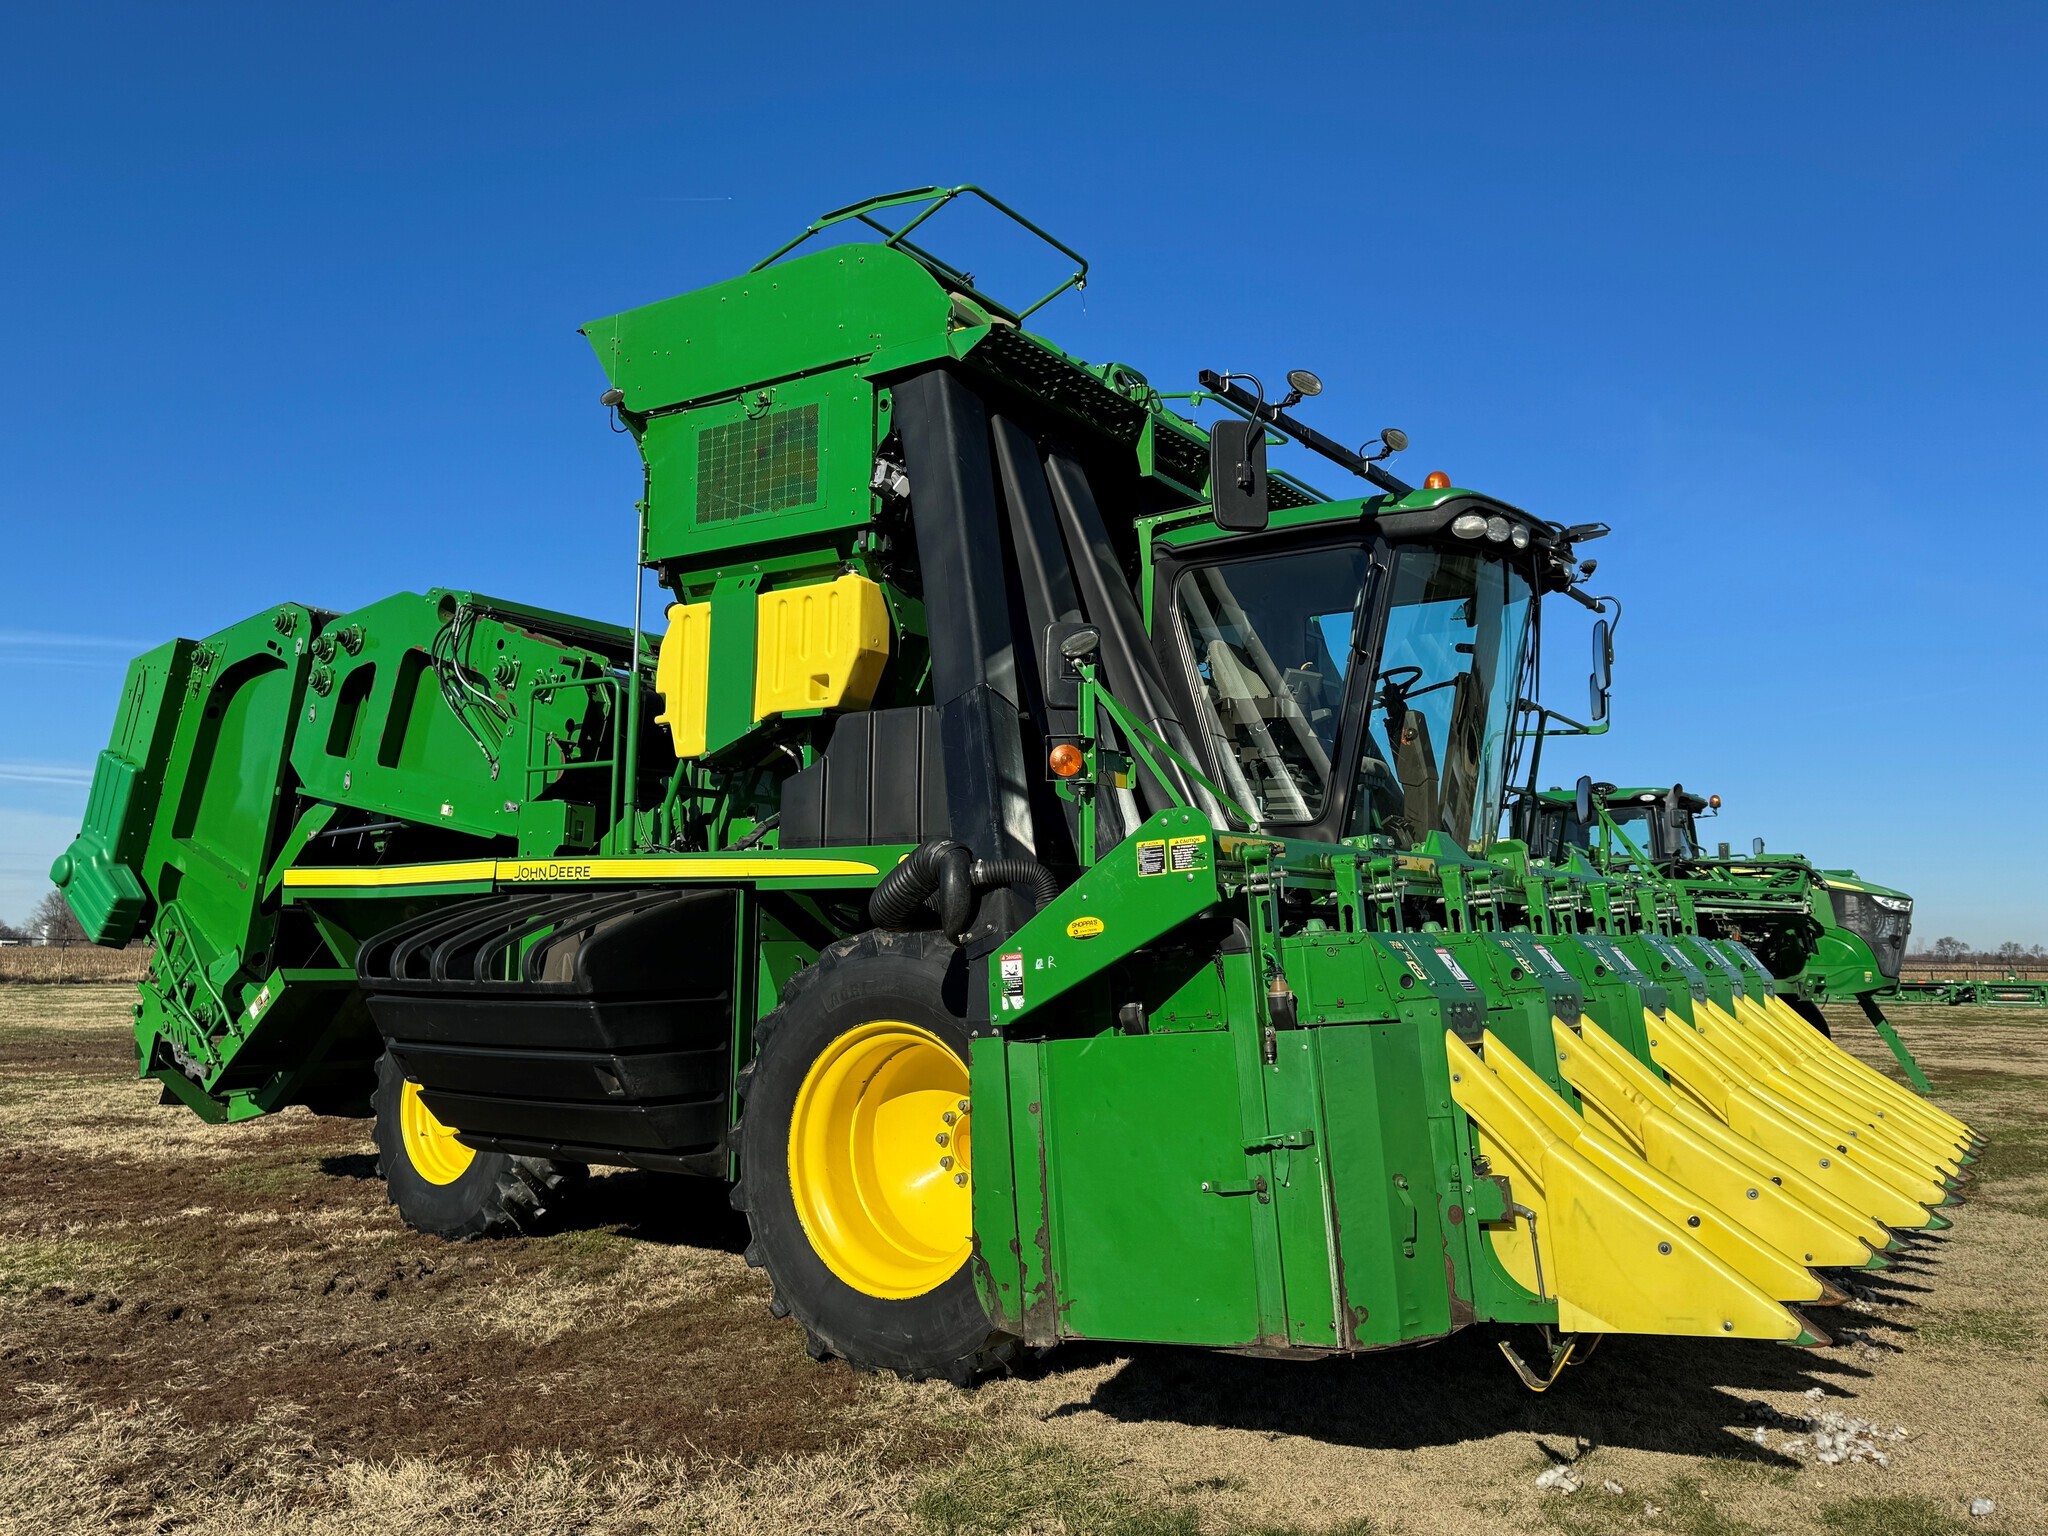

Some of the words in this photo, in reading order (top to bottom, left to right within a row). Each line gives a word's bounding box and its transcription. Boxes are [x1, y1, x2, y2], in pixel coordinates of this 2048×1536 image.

[514, 864, 547, 879] JOHN
[549, 864, 591, 878] DEERE
[1071, 919, 1098, 929] SHOPPA'S
